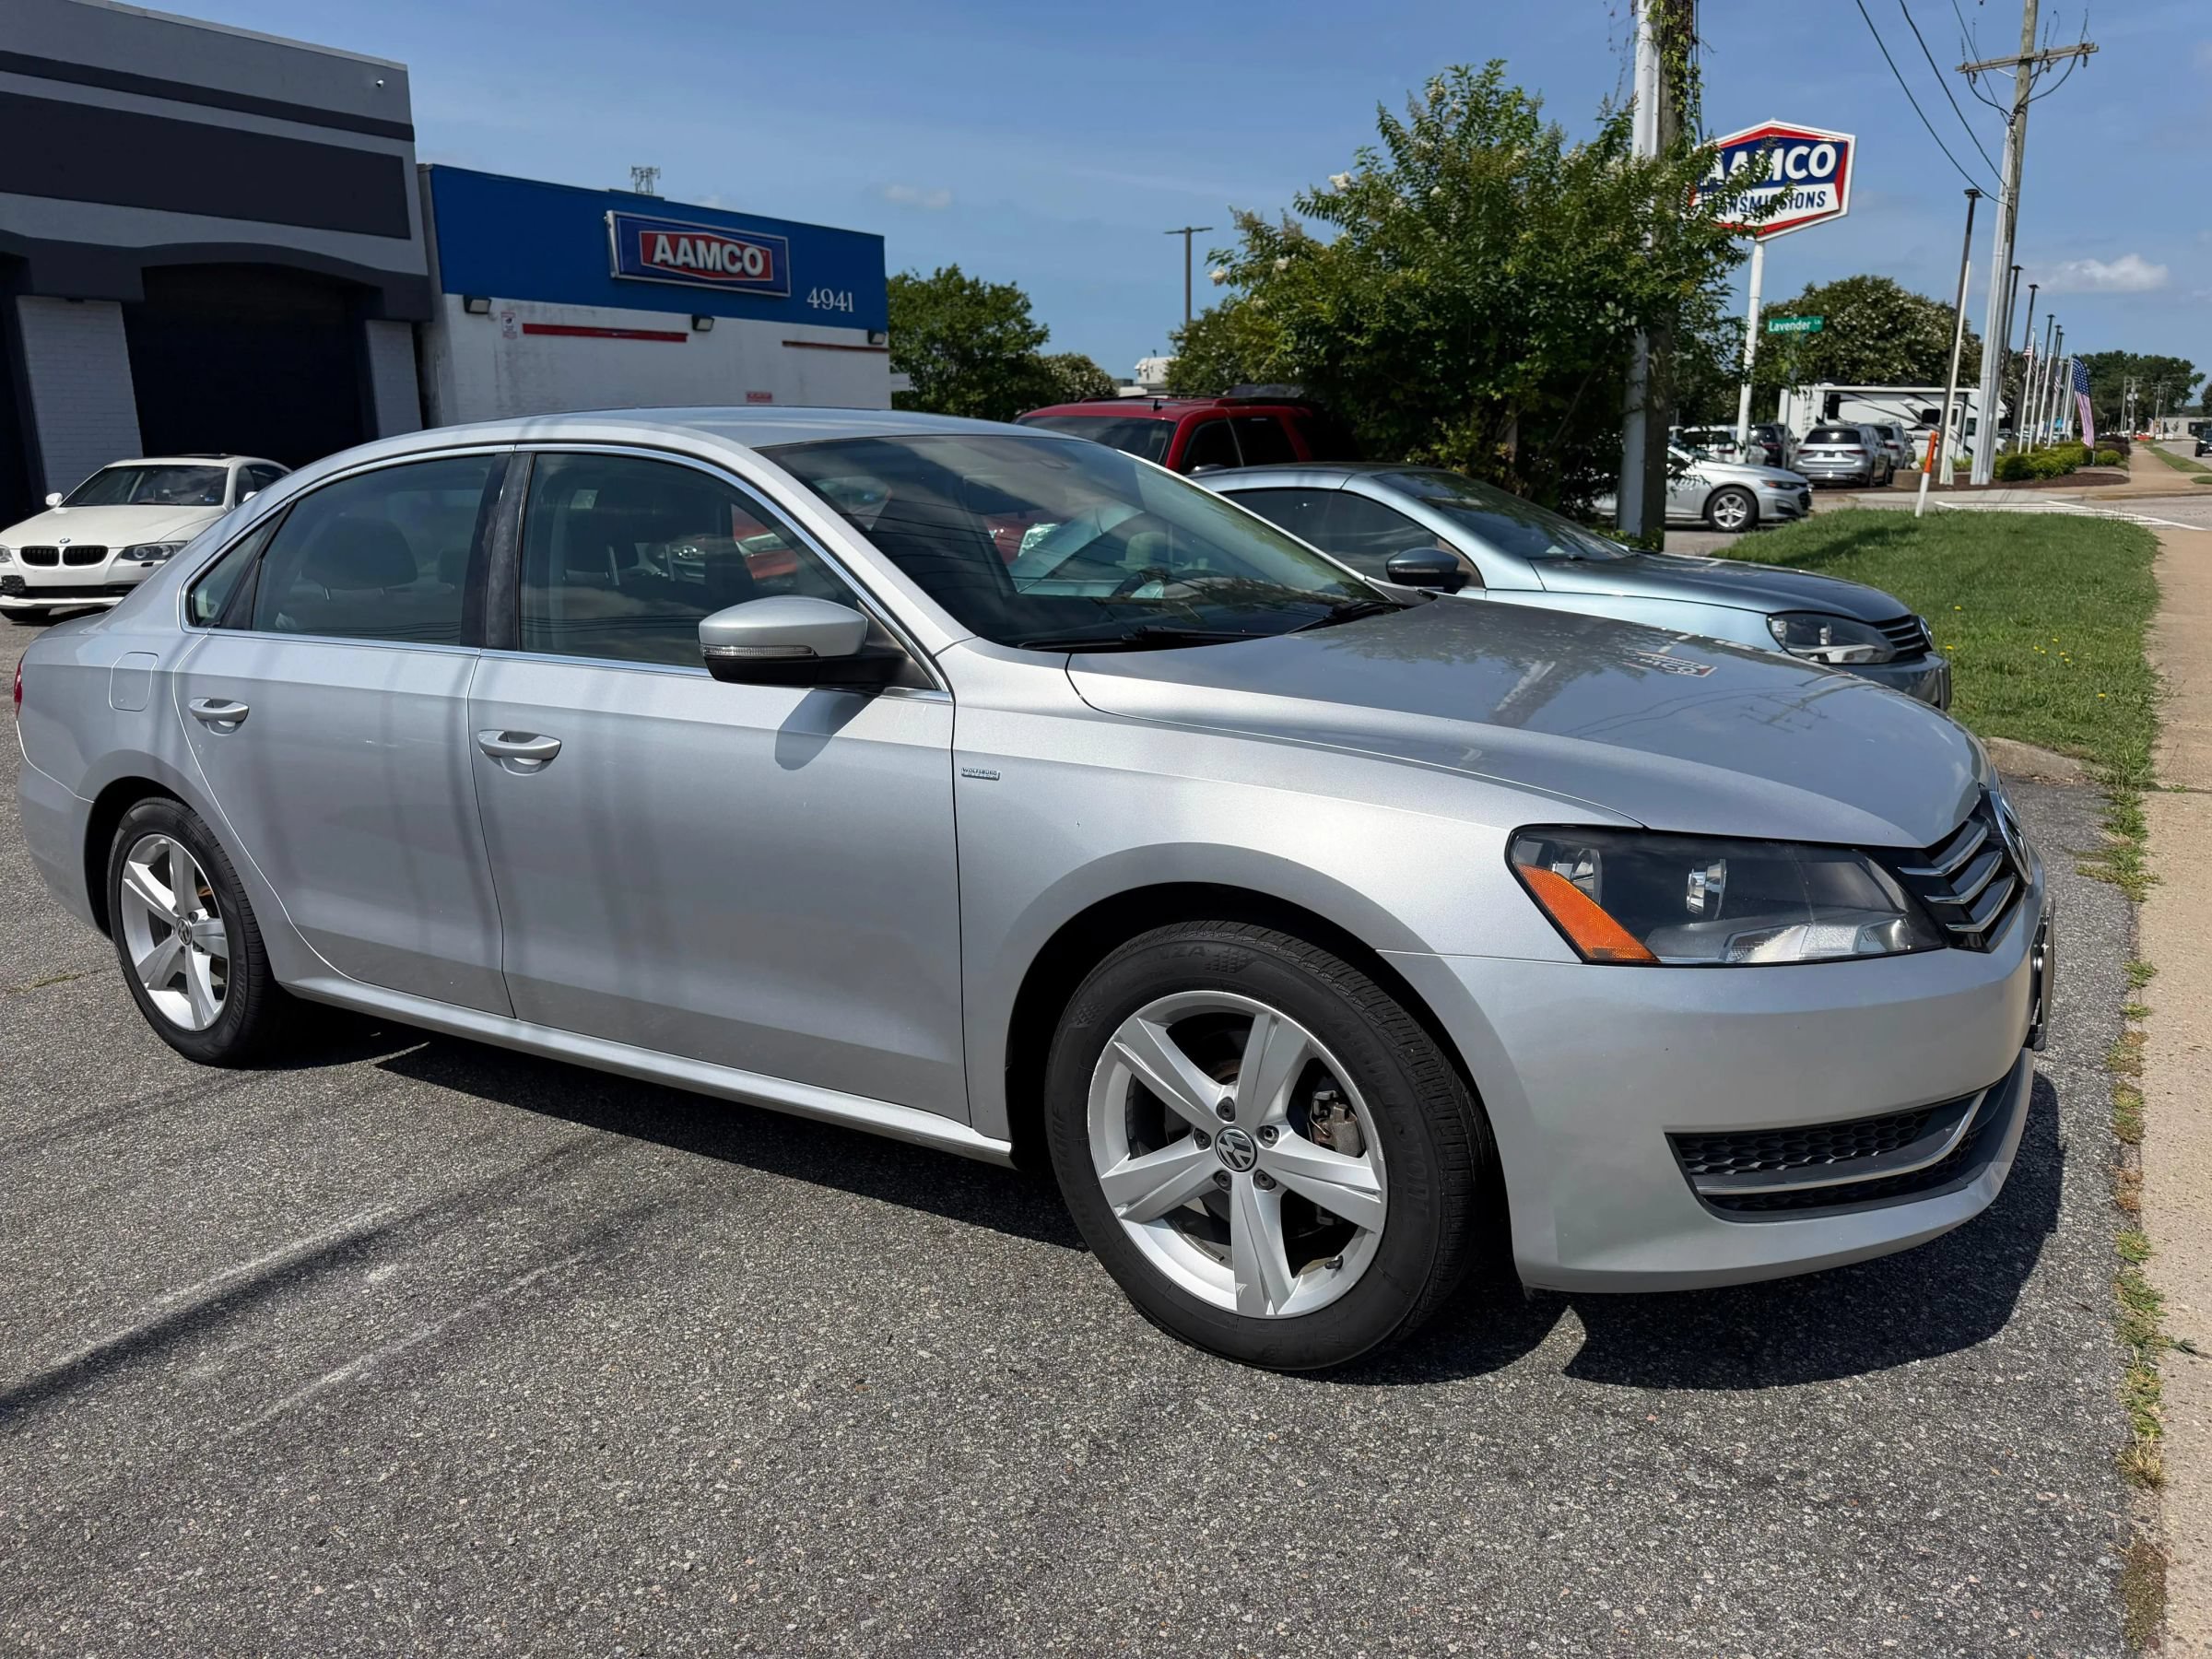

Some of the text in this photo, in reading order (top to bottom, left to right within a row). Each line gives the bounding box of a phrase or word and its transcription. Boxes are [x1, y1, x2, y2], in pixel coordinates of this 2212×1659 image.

[653, 234, 764, 276] AAMCO
[806, 287, 853, 312] 4941
[1769, 320, 1811, 332] Lavender
